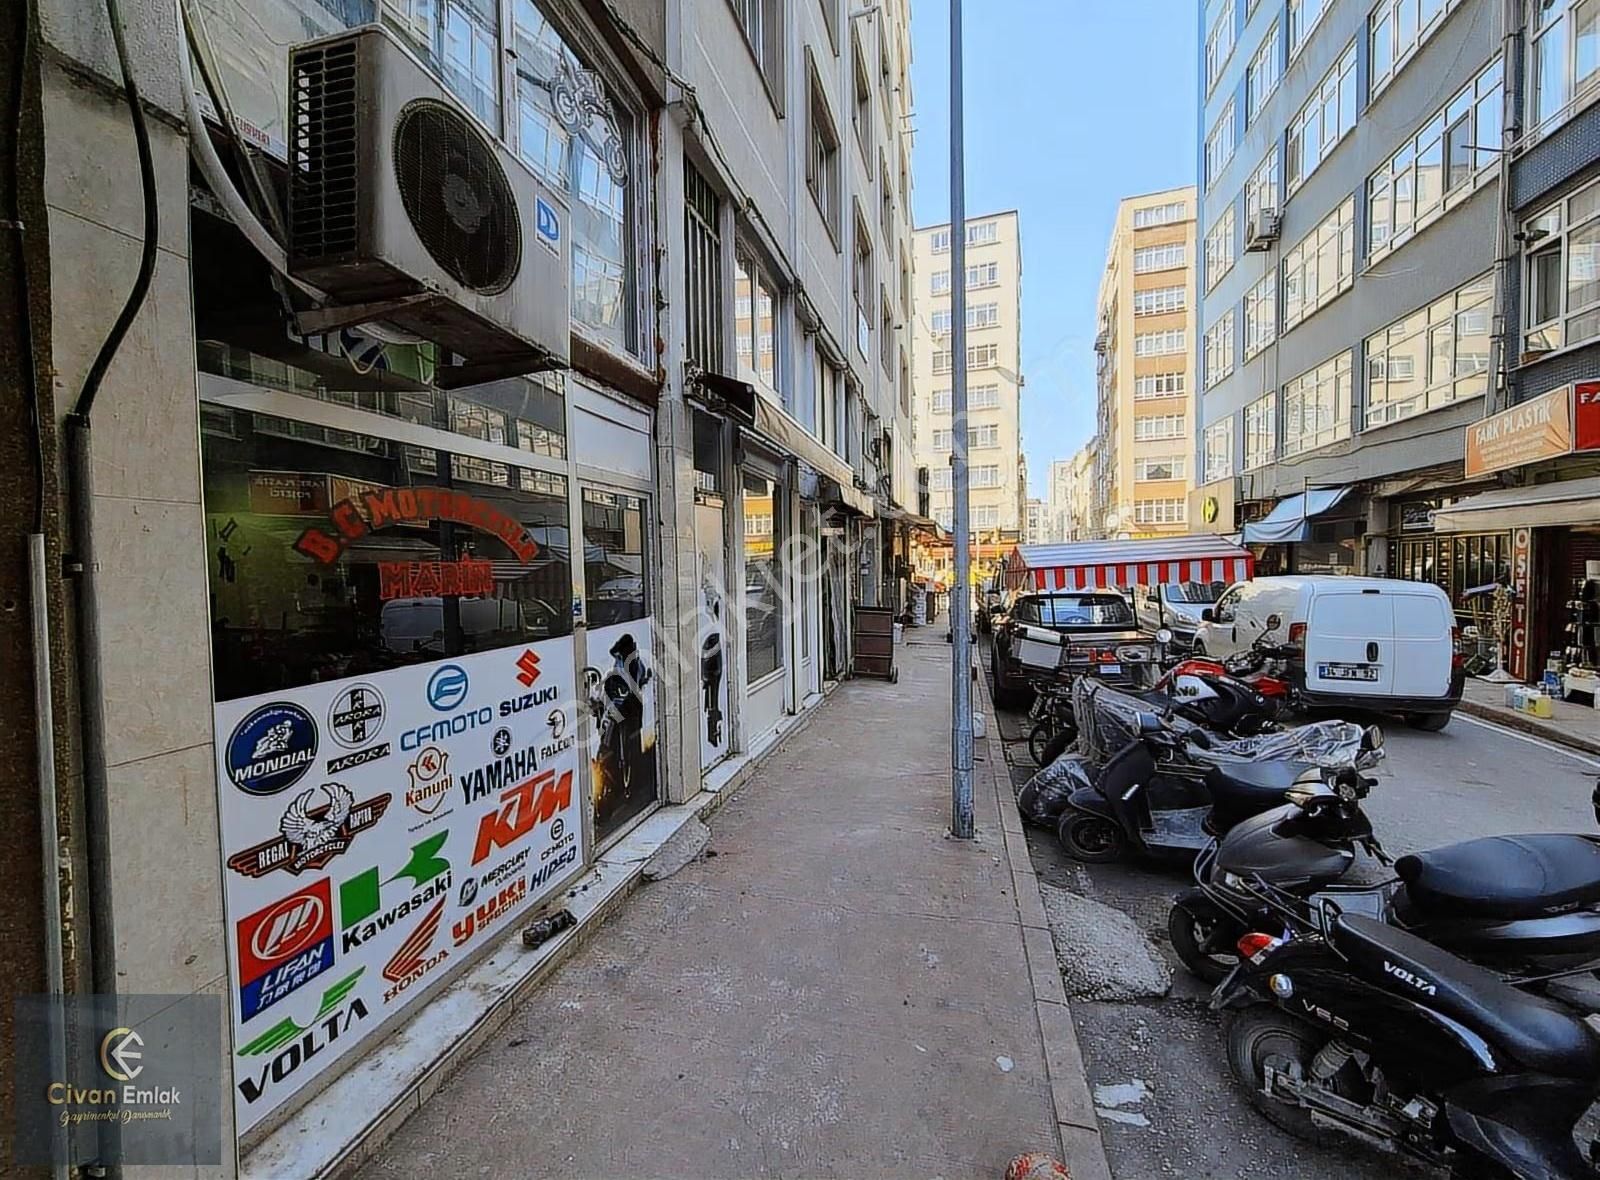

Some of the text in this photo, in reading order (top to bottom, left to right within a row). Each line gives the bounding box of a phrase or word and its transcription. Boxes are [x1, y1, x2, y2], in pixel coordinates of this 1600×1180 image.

[499, 686, 558, 717] SUZUKI
[400, 707, 493, 751] CFMOTO
[234, 748, 316, 783] MONDIAL
[328, 745, 391, 773] ARORA
[460, 746, 538, 805] YAMAHA
[405, 773, 453, 807] Kanuni
[471, 769, 574, 866] KTM
[258, 841, 290, 869] REGAL
[481, 846, 531, 888] MERCURY
[342, 870, 452, 955] Kawasaki
[261, 942, 326, 994] LIFAN
[383, 949, 450, 1004] HONDA
[1384, 960, 1436, 996] VOLTA
[238, 997, 369, 1104] VOLTA
